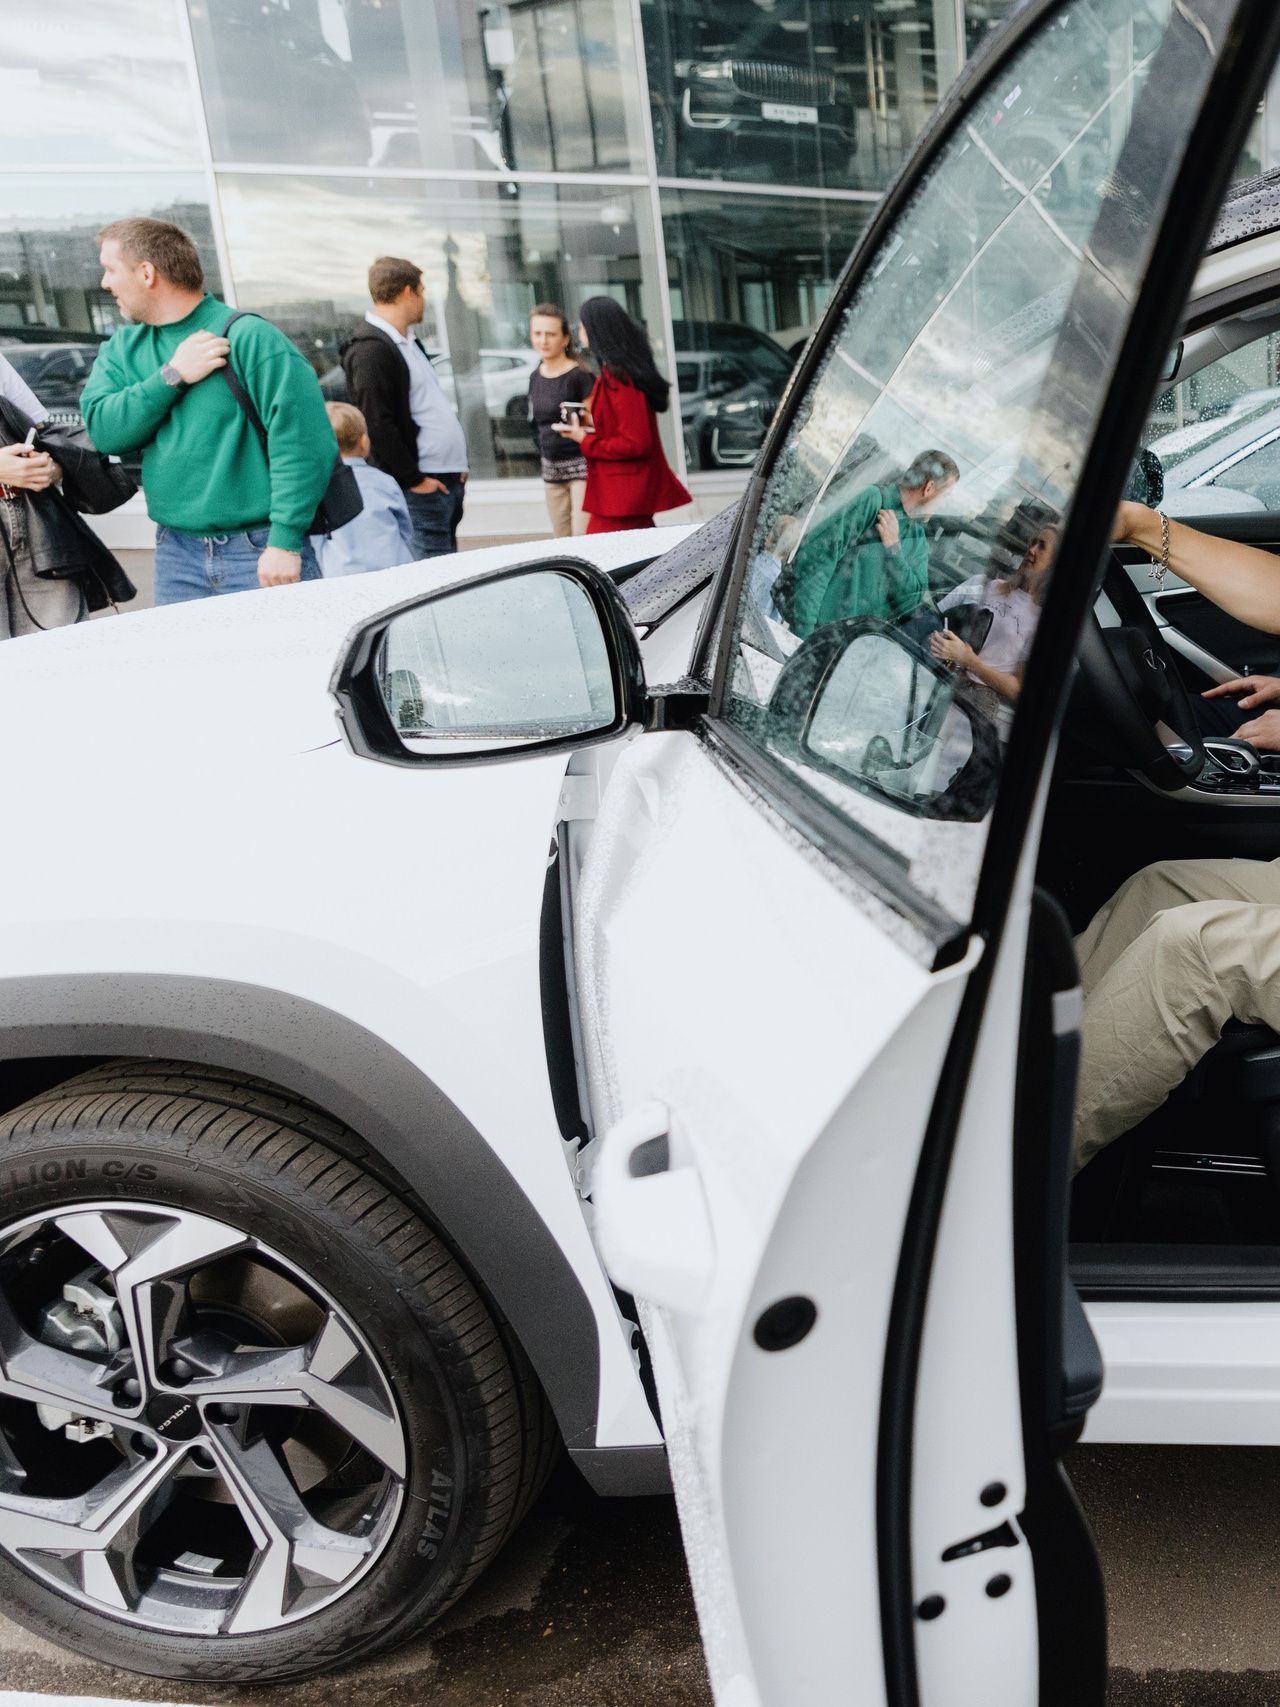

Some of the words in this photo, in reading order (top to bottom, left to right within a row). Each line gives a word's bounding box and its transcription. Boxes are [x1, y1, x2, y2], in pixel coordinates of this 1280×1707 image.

[101, 1160, 159, 1181] C/S
[157, 1404, 192, 1431] VOLGA
[416, 1467, 454, 1561] ATLAS
